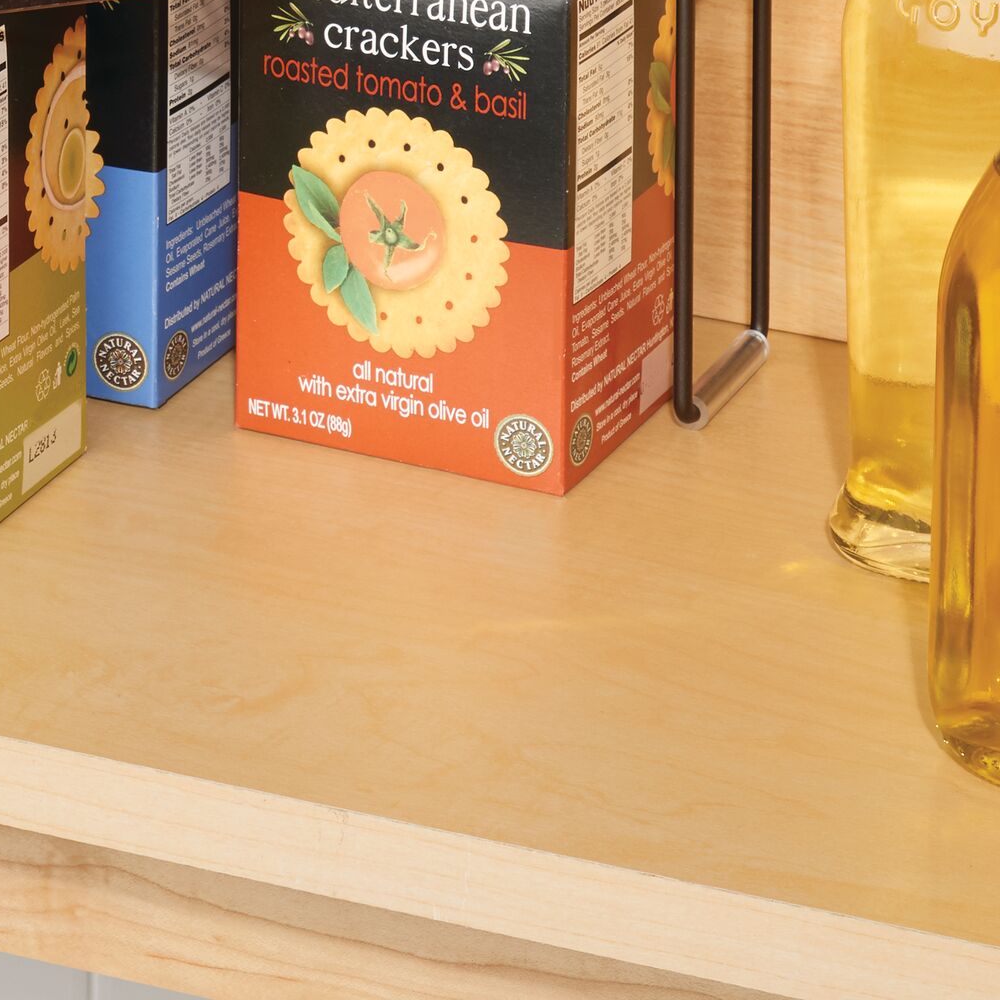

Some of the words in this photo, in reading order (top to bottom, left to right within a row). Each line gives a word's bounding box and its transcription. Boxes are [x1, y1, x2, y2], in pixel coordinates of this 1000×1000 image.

[169, 27, 196, 47] Cholesterol
[323, 22, 475, 71] crackers
[182, 42, 212, 64] Carbohydrate
[263, 53, 349, 90] roasted
[356, 64, 443, 107] tomato
[450, 81, 467, 111] &
[475, 84, 527, 120] basil
[165, 271, 189, 293] Contains
[164, 301, 194, 330] Distributed
[201, 278, 226, 305] NATURAL
[98, 337, 142, 365] NATURAL
[100, 363, 142, 386] NECTAR
[352, 360, 371, 382] all
[375, 366, 434, 394] natural
[570, 384, 597, 413] Distributed
[603, 360, 627, 387] NATURAL
[626, 342, 647, 366] NECTAR
[571, 361, 593, 383] Contains
[298, 374, 332, 397] with
[336, 384, 377, 407] extra
[381, 390, 424, 418] virgin
[428, 399, 467, 425] olive
[471, 407, 490, 429] oil
[248, 397, 270, 417] NET
[271, 401, 291, 422] WT.
[291, 407, 307, 425] 3.1
[309, 410, 326, 429] OZ
[326, 413, 353, 438] (88g)
[5, 419, 29, 445] NECTAR
[500, 420, 547, 449] NATURAL
[501, 446, 547, 470] NECTAR
